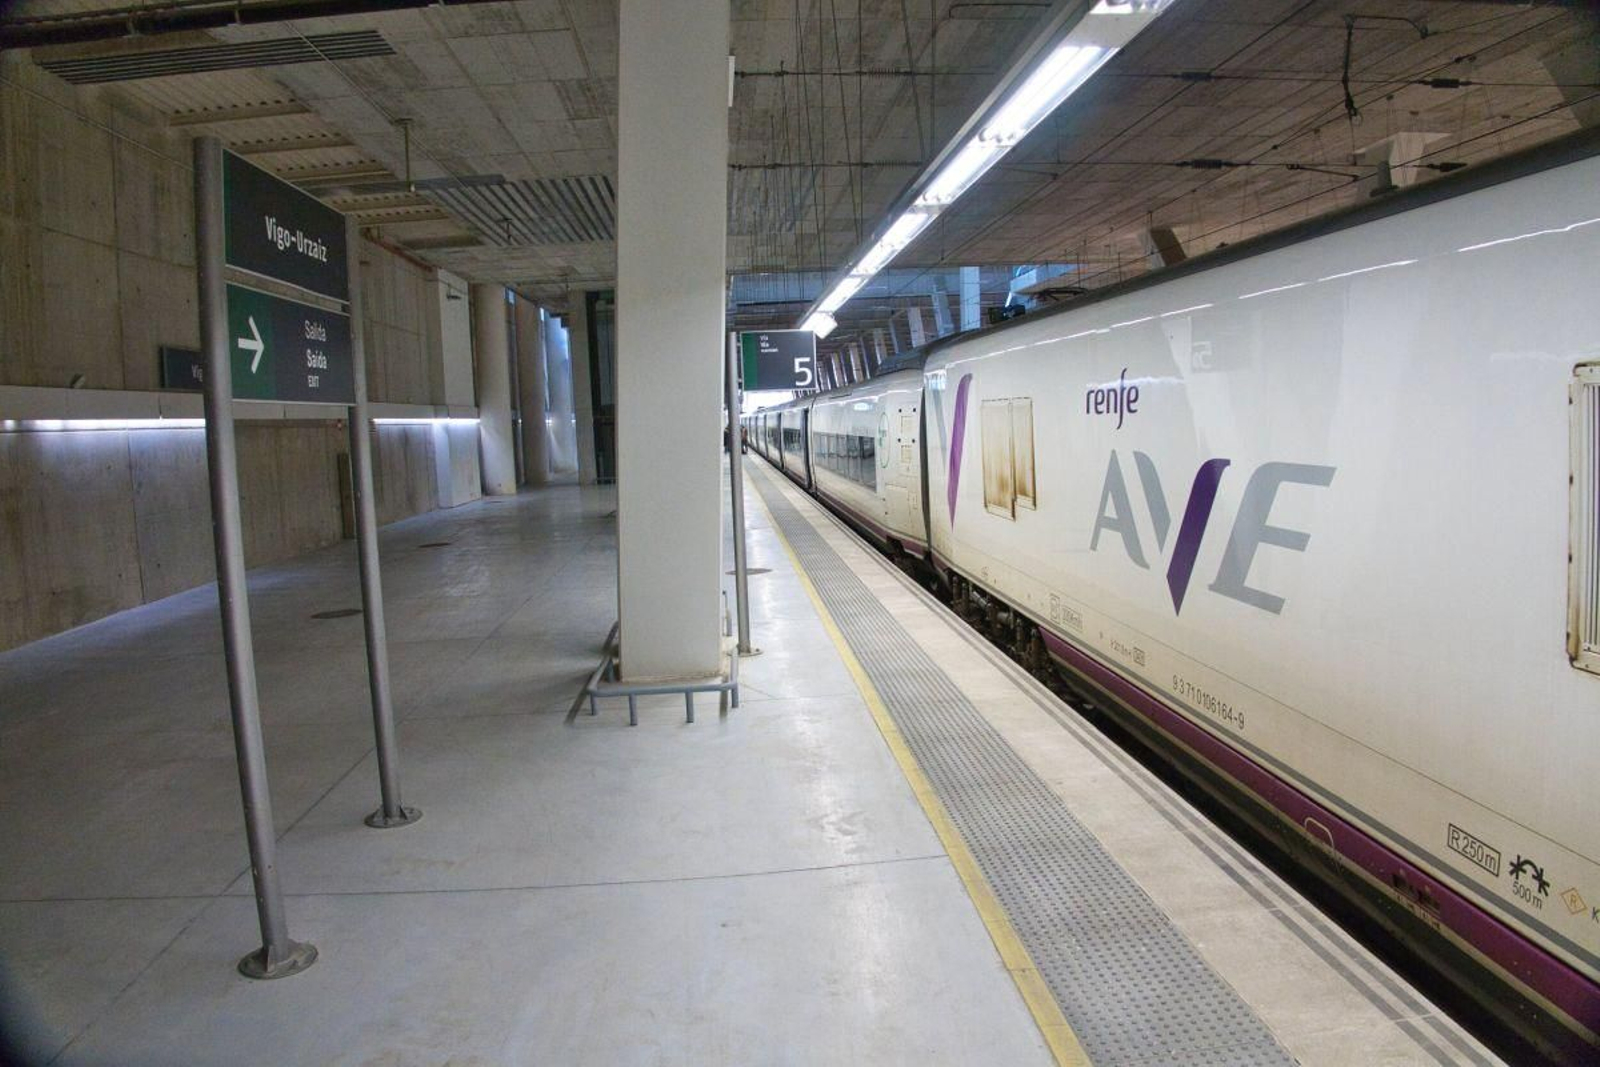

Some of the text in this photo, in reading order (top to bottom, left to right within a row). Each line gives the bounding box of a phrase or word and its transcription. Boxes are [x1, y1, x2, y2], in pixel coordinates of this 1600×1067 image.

[264, 215, 328, 262] Vigo-Urzaiz
[304, 319, 327, 342] Salida
[794, 356, 813, 386] 5
[1086, 367, 1139, 430] renfe
[1090, 449, 1337, 616] AVE
